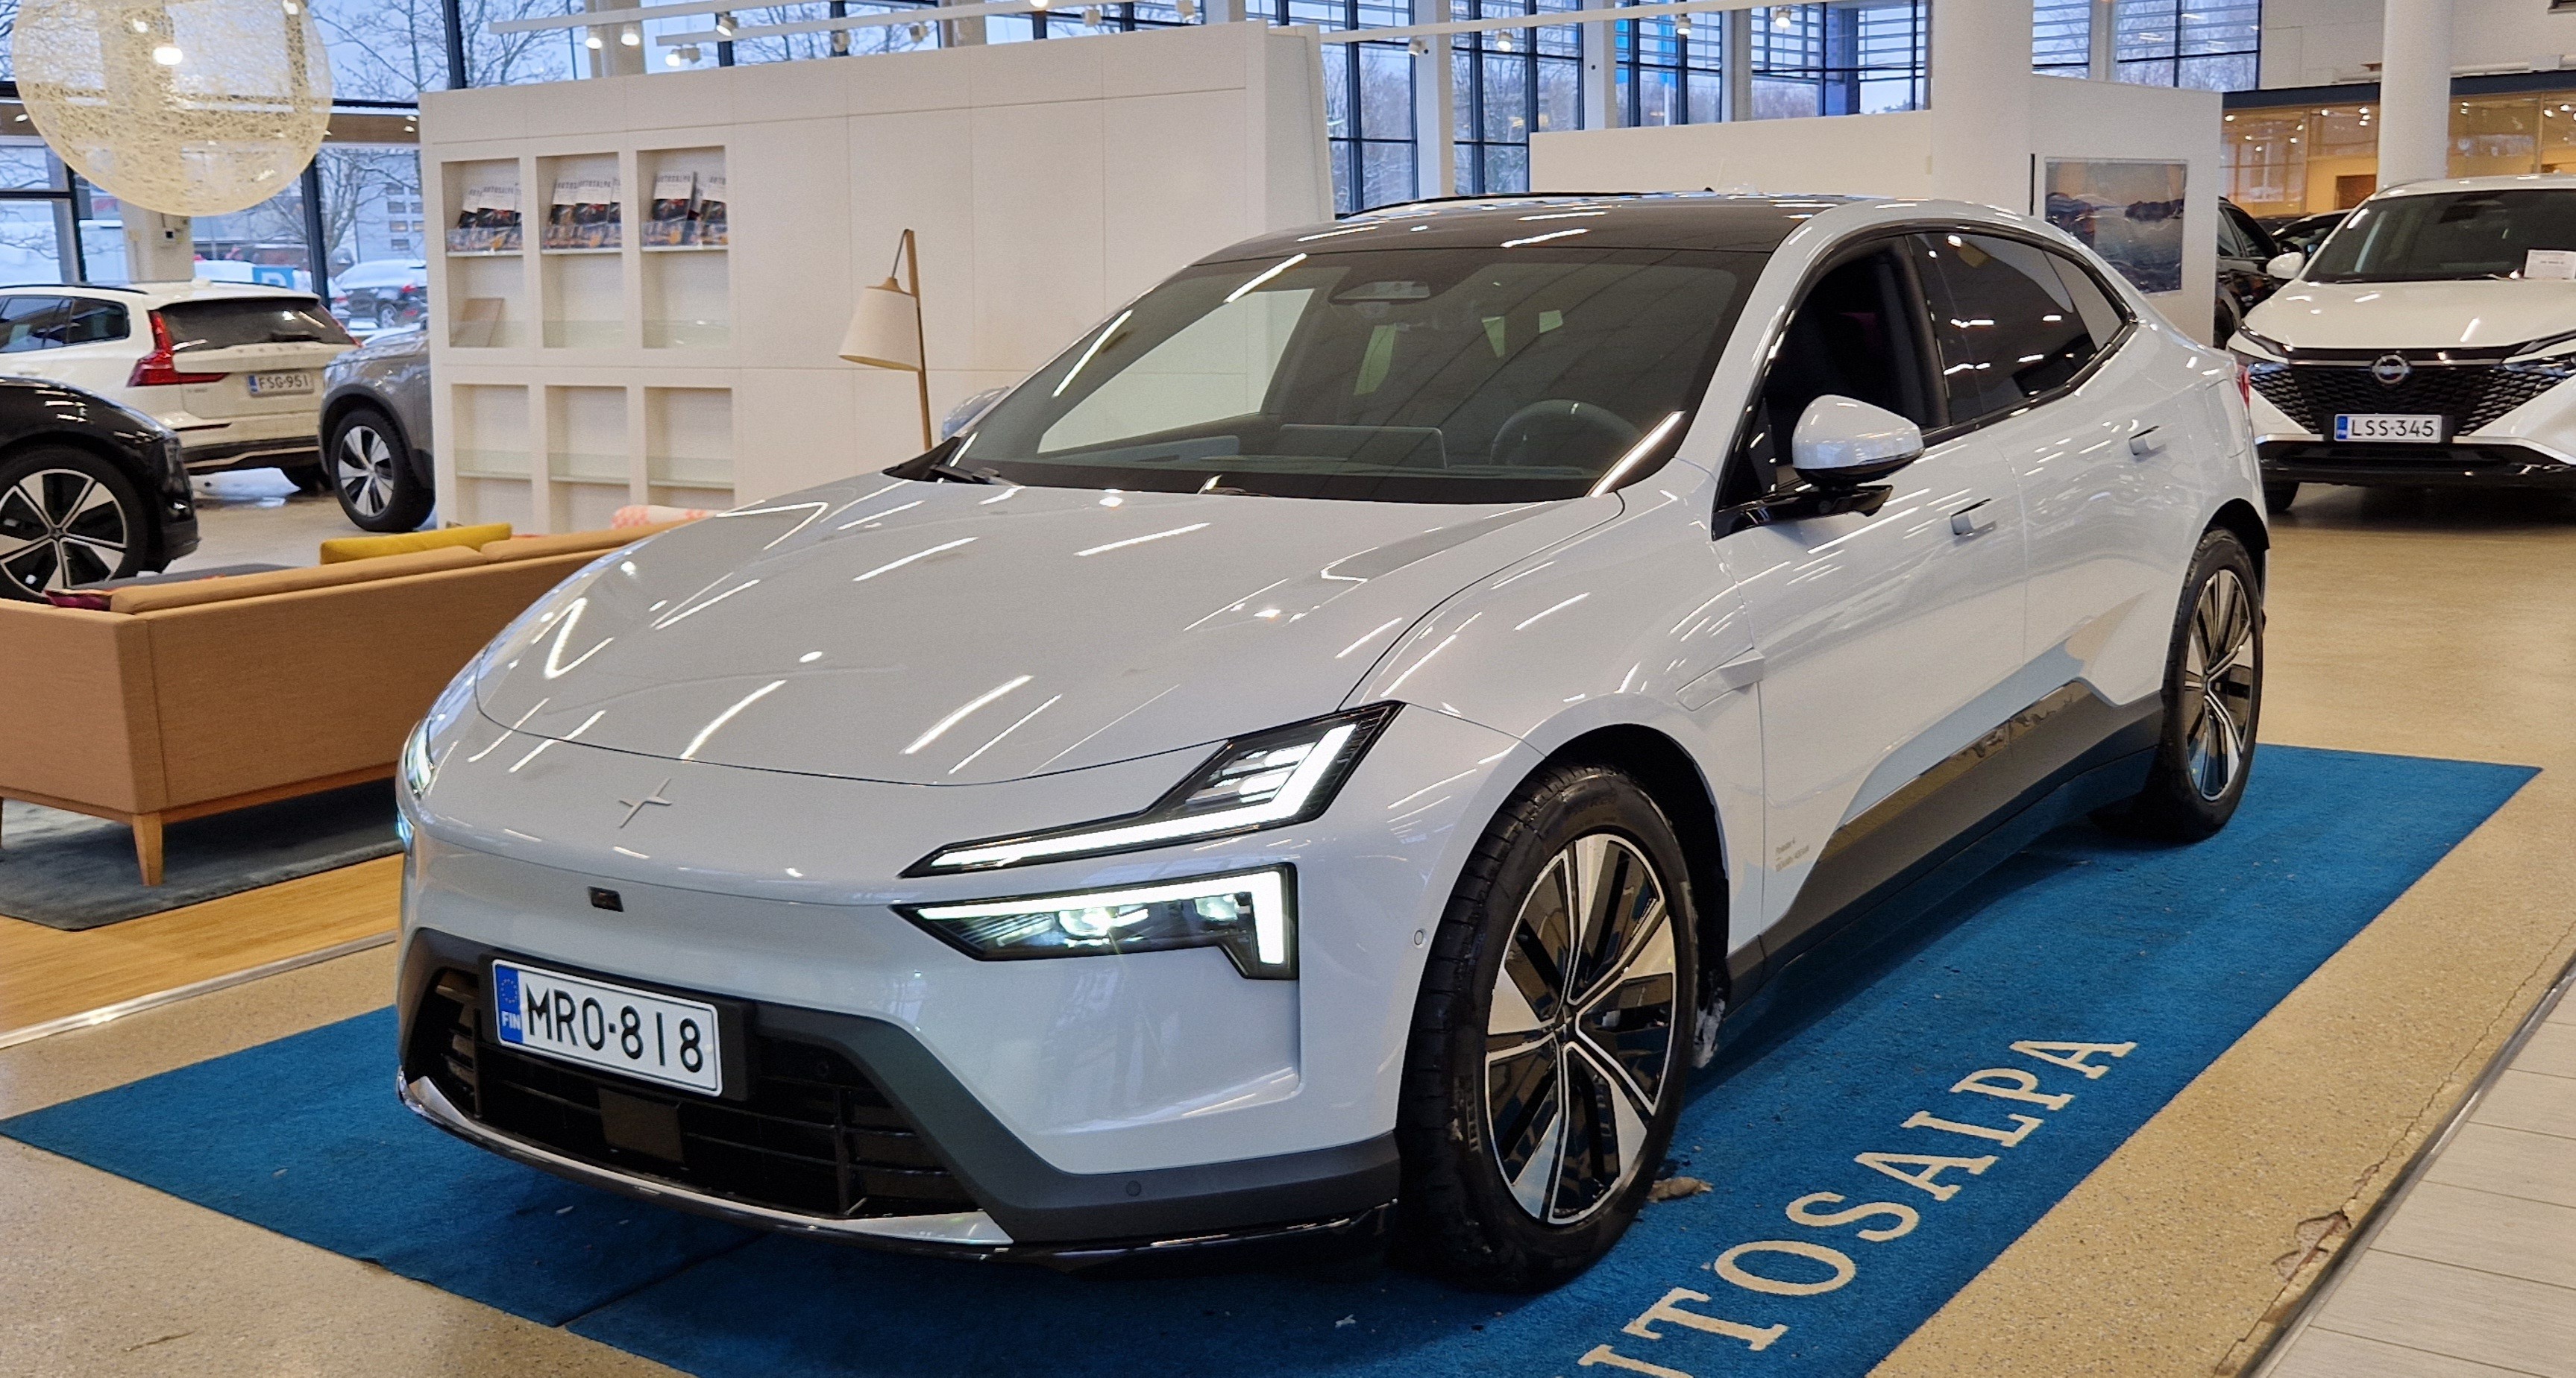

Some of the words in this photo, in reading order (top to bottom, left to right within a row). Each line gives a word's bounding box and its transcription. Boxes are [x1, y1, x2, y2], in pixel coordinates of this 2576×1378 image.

[258, 374, 308, 388] FSG-951
[2351, 420, 2434, 437] LSS-345
[502, 1011, 522, 1031] FIN
[525, 983, 704, 1073] MRO-818
